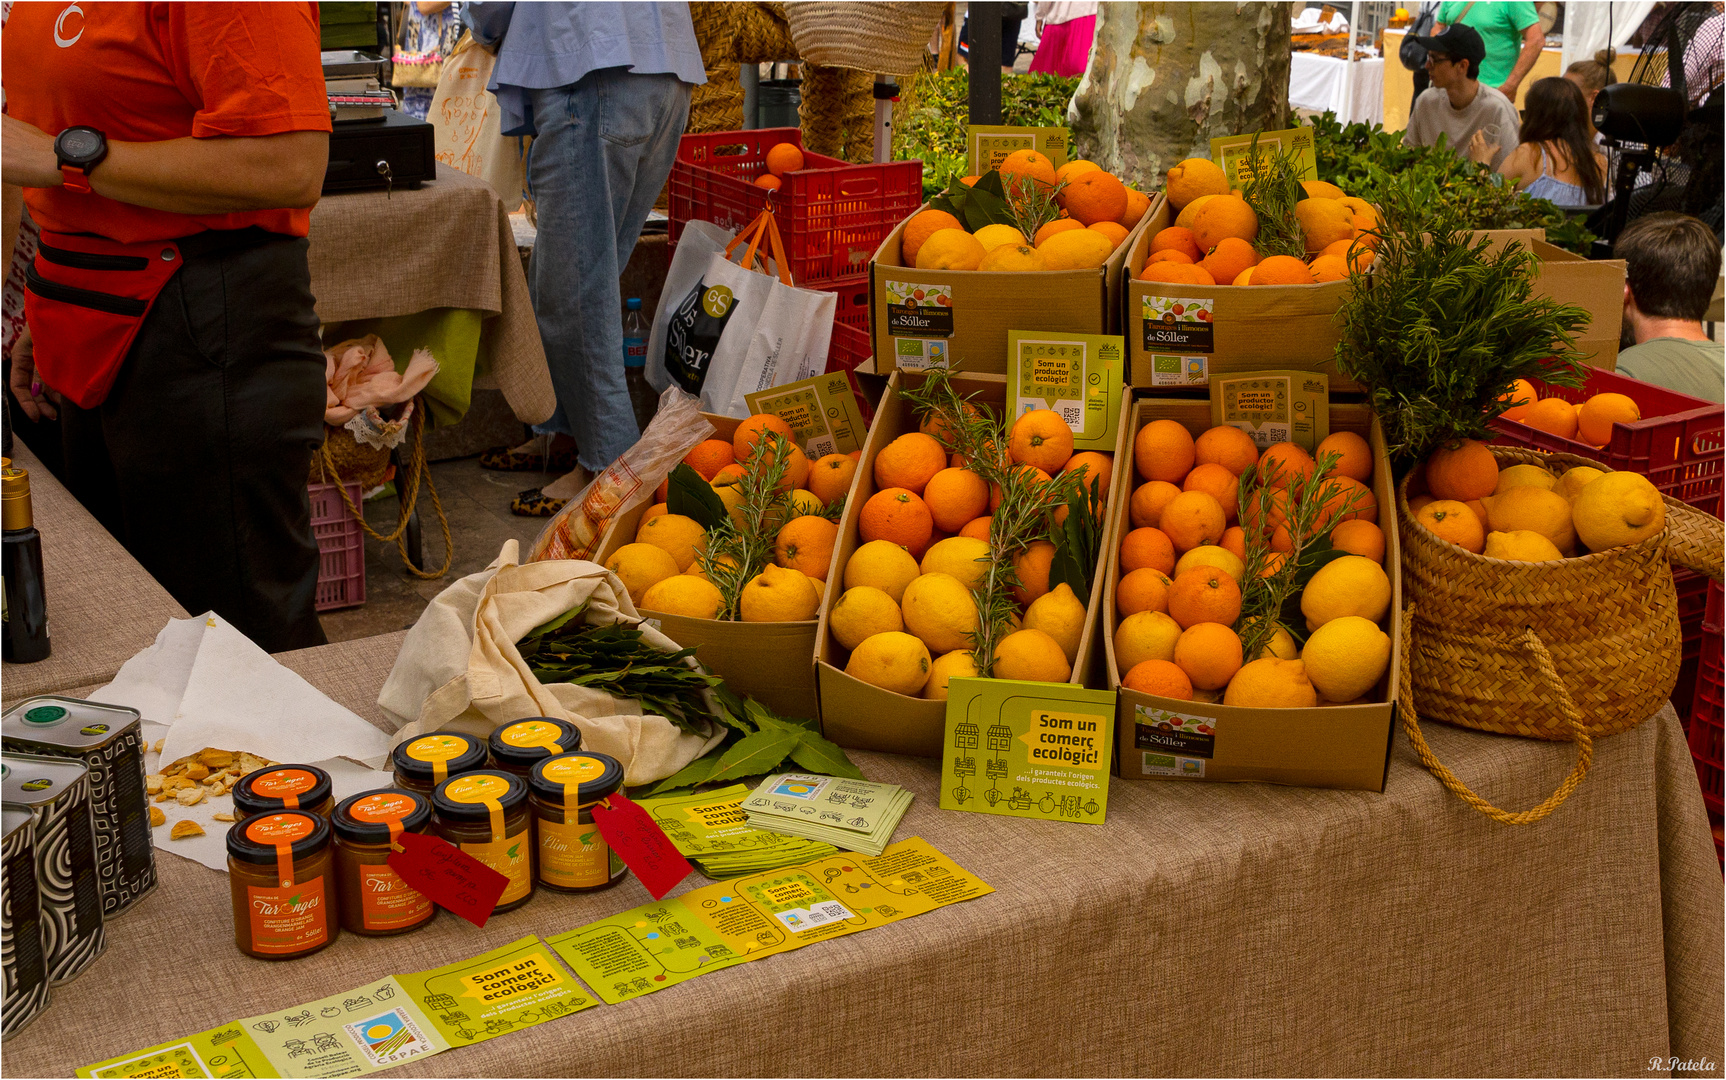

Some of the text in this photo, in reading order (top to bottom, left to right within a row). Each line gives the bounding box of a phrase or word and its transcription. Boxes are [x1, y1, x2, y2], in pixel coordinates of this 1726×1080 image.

[900, 315, 930, 327] Sóller
[1147, 323, 1177, 331] Taronges
[1181, 324, 1209, 332] llimones
[1156, 331, 1189, 343] Sóller
[1038, 360, 1054, 368] Som
[1034, 368, 1069, 376] productor
[1035, 375, 1068, 384] ecològic!
[779, 409, 795, 417] Som
[783, 413, 810, 423] roductor
[789, 418, 811, 429] ològic!
[1040, 715, 1097, 732] Som un
[1040, 733, 1094, 750] comerç
[1150, 734, 1187, 748] Sóller
[1033, 747, 1098, 765] ecològic!
[1034, 770, 1067, 778] garanteix
[1069, 772, 1095, 780] l'origen
[1031, 777, 1066, 786] productes
[1067, 779, 1100, 789] ecològics.
[693, 805, 726, 814] Som
[768, 886, 788, 894] Som
[774, 888, 804, 898] comerç
[305, 927, 323, 938] Sóller
[472, 959, 536, 984] Som un
[482, 968, 544, 991] comerç
[483, 973, 556, 1000] ecològic!
[480, 1011, 497, 1019] dels
[499, 1000, 536, 1014] productes
[376, 1044, 430, 1065] CBPAE
[157, 1065, 172, 1073] un
